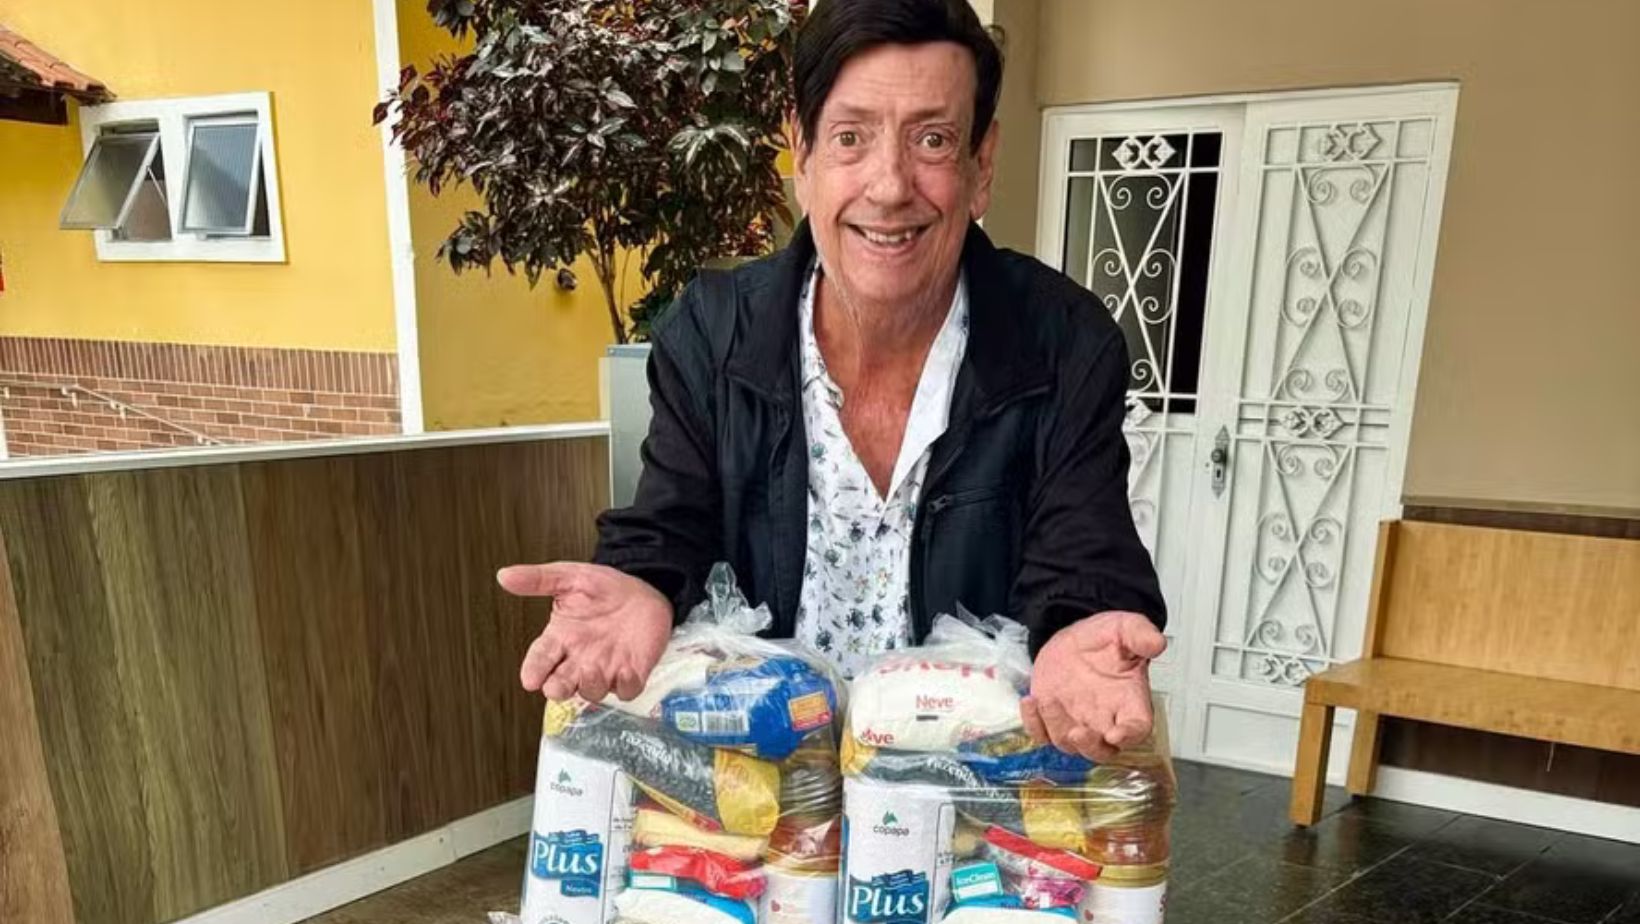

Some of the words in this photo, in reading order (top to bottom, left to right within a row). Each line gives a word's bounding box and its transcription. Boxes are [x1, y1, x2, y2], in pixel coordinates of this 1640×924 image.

[915, 694, 954, 709] Neve
[550, 782, 583, 796] copapa
[873, 825, 910, 836] copapa
[533, 839, 598, 875] Plus
[851, 885, 925, 917] Plus
